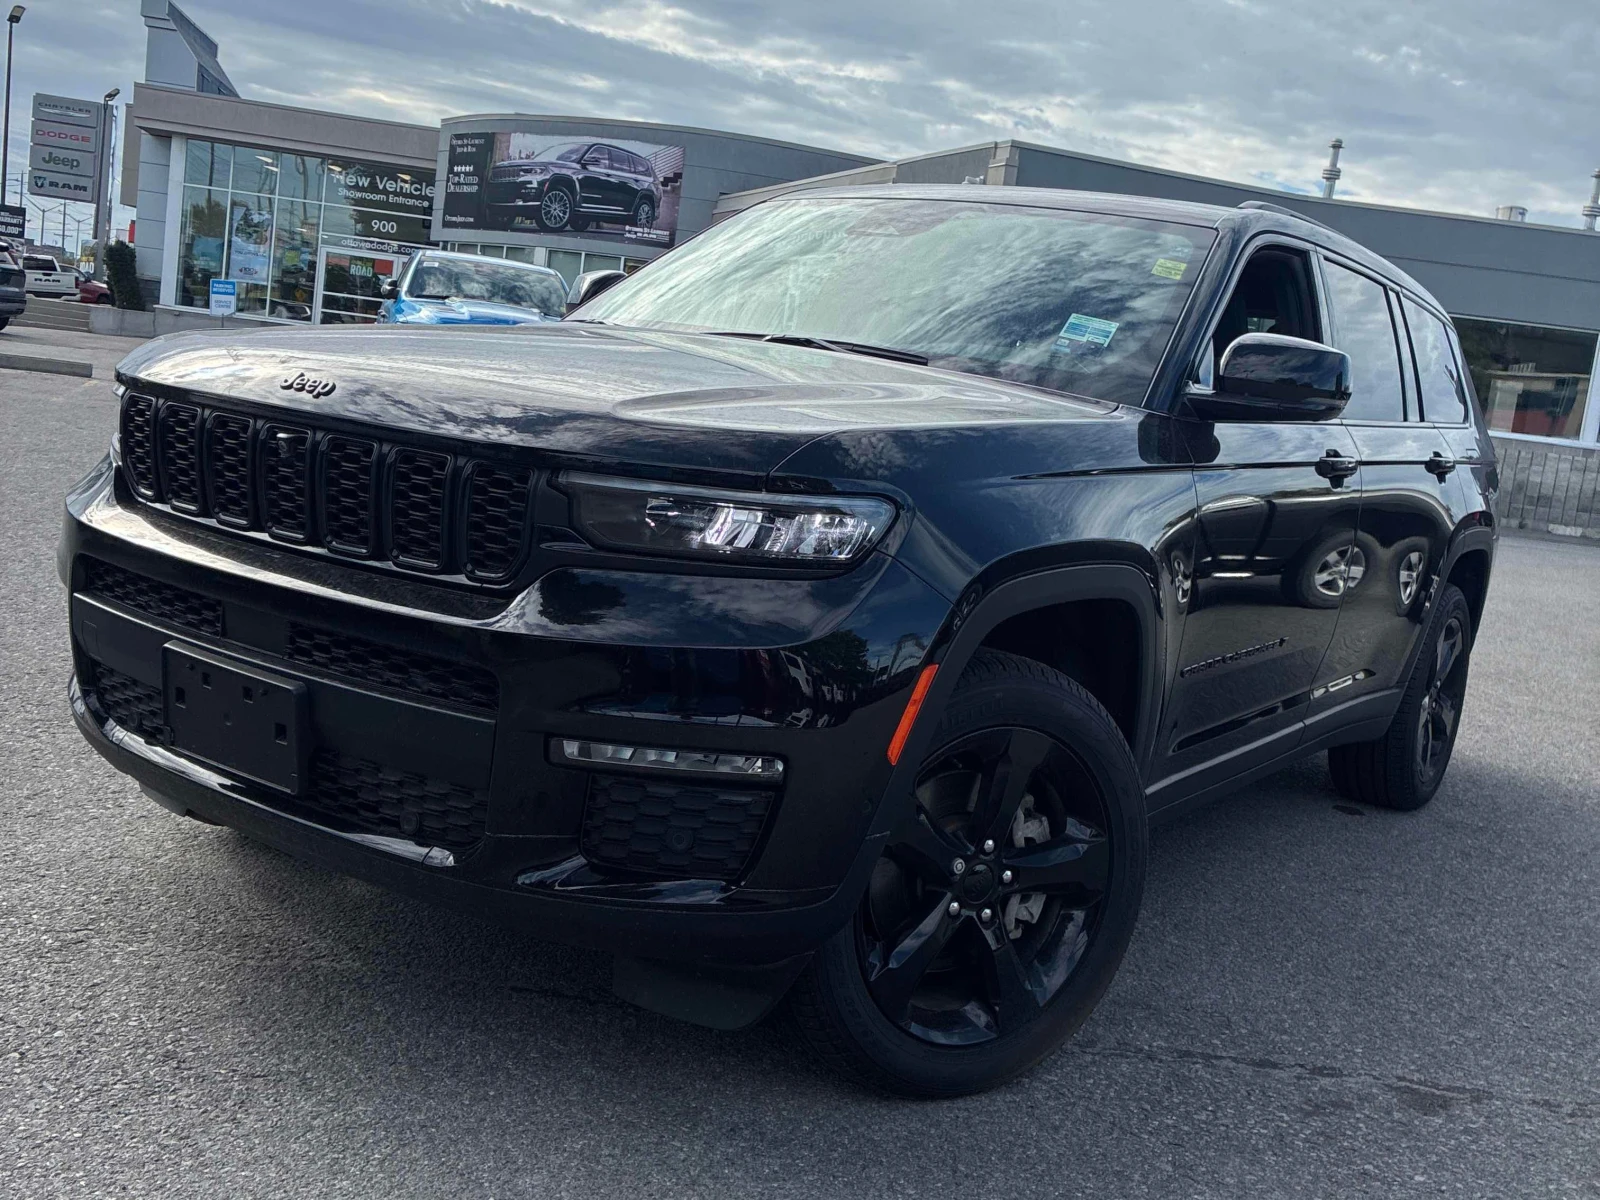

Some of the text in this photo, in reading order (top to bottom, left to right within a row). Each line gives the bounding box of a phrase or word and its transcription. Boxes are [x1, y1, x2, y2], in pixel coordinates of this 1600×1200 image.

[38, 102, 91, 113] CHRYSLER
[35, 129, 91, 143] DODGE
[41, 151, 80, 170] Jeep
[48, 180, 88, 192] RAM
[333, 170, 371, 188] New
[338, 188, 429, 208] Showroom Entrance
[371, 219, 397, 234] 900
[350, 264, 373, 277] ROAD
[280, 371, 336, 399] Jeep
